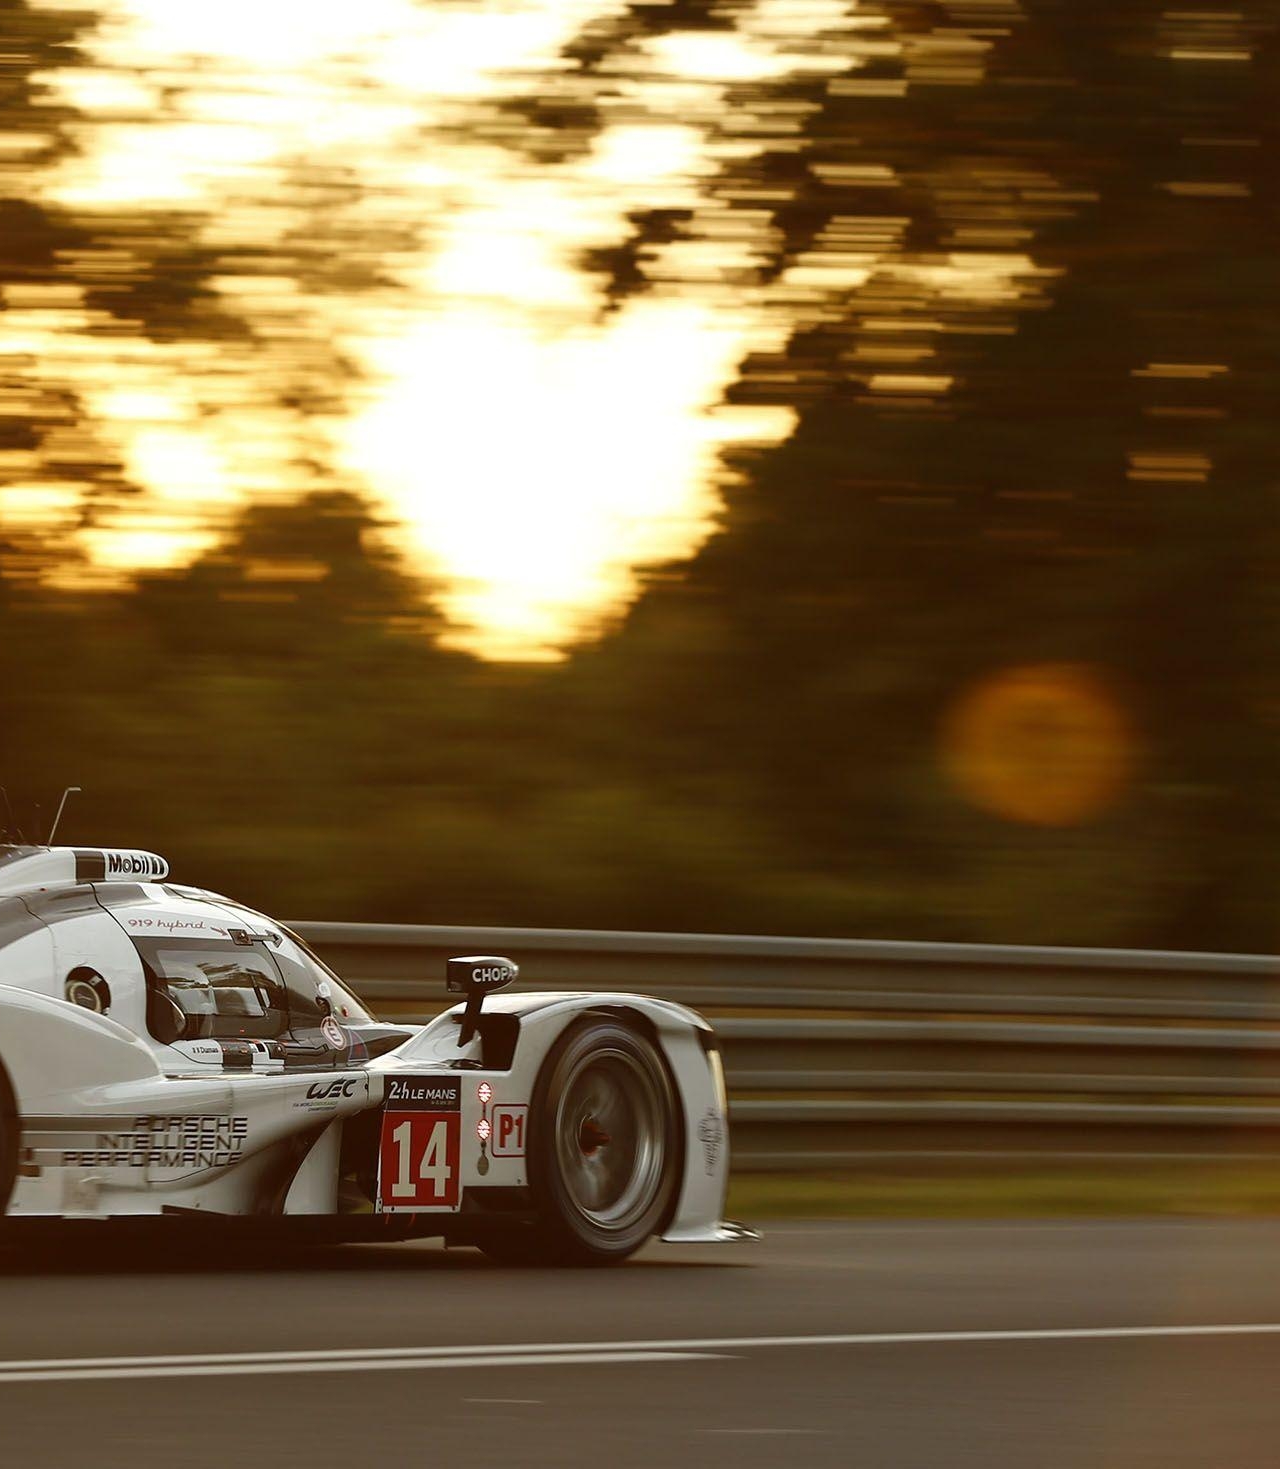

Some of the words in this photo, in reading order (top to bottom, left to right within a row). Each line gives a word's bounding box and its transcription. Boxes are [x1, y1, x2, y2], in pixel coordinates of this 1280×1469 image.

[107, 853, 149, 874] Mobil
[128, 919, 153, 928] 919
[157, 919, 206, 933] hybrid
[306, 1078, 357, 1099] WEC
[411, 1088, 425, 1099] LE
[426, 1088, 457, 1100] MANS
[133, 1116, 248, 1133] PORSCHE
[498, 1113, 524, 1148] P1
[96, 1134, 248, 1150] INTELLIGENT
[62, 1151, 243, 1168] PERFORMANCE
[391, 1121, 452, 1197] 14
